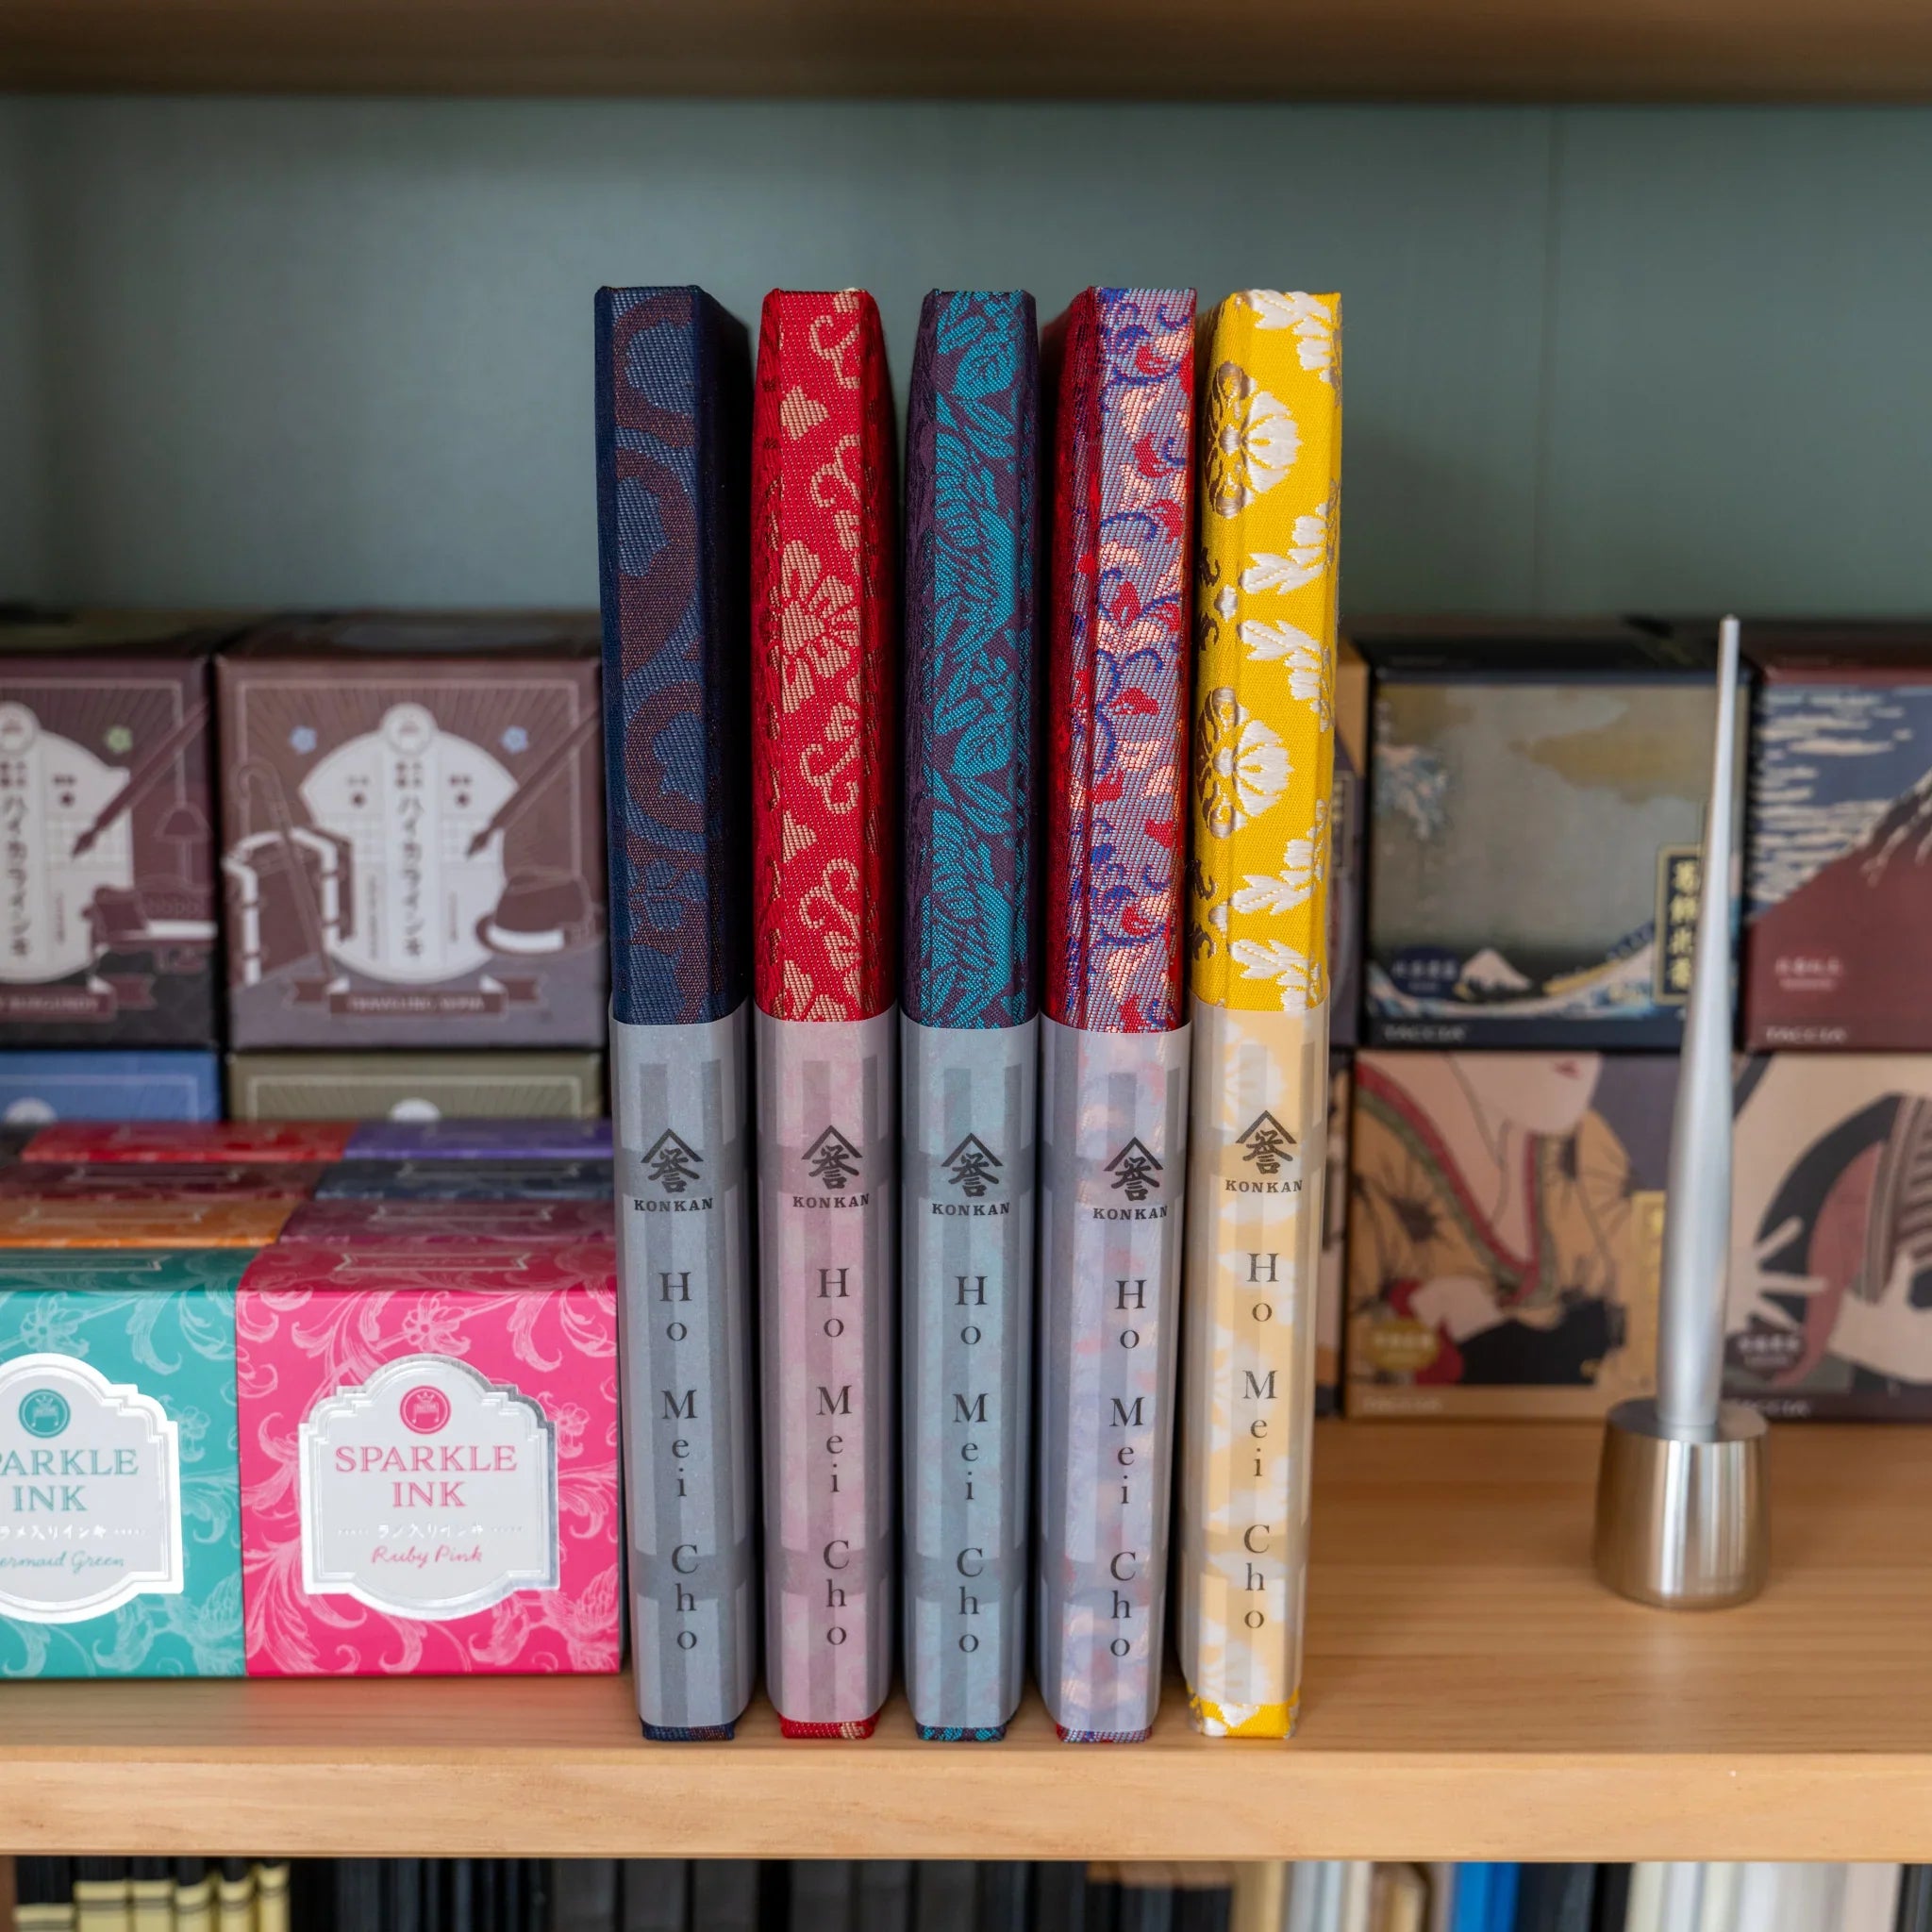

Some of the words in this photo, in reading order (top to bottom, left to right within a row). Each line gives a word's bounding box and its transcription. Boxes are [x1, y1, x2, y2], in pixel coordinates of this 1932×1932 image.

[634, 1197, 714, 1212] KONKAN
[792, 1193, 870, 1208] KONKAN
[932, 1202, 1010, 1216] KONKAN
[1092, 1206, 1168, 1221] KONKAN
[1225, 1179, 1303, 1193] KONKAN
[659, 1271, 692, 1341] Ho
[817, 1267, 850, 1338] Ho
[955, 1275, 988, 1344] Ho
[1114, 1279, 1147, 1349] Ho
[1246, 1253, 1279, 1322] Ho
[661, 1390, 699, 1497] Mei
[815, 1385, 853, 1492] Mei
[952, 1393, 989, 1500] Mei
[1108, 1396, 1145, 1505] Mei
[1242, 1370, 1278, 1477] Mei
[0, 1449, 139, 1475] ARKLE
[335, 1445, 518, 1473] SPARKLE
[13, 1485, 88, 1512] INK
[391, 1481, 466, 1507] INK
[71, 1551, 125, 1574] Green
[372, 1545, 429, 1569] Ruby
[434, 1544, 483, 1563] Pink
[1243, 1524, 1270, 1629] Cho
[672, 1544, 700, 1650] Cho
[823, 1540, 852, 1646] Cho
[957, 1547, 984, 1653] Cho
[1109, 1552, 1137, 1657] Cho
